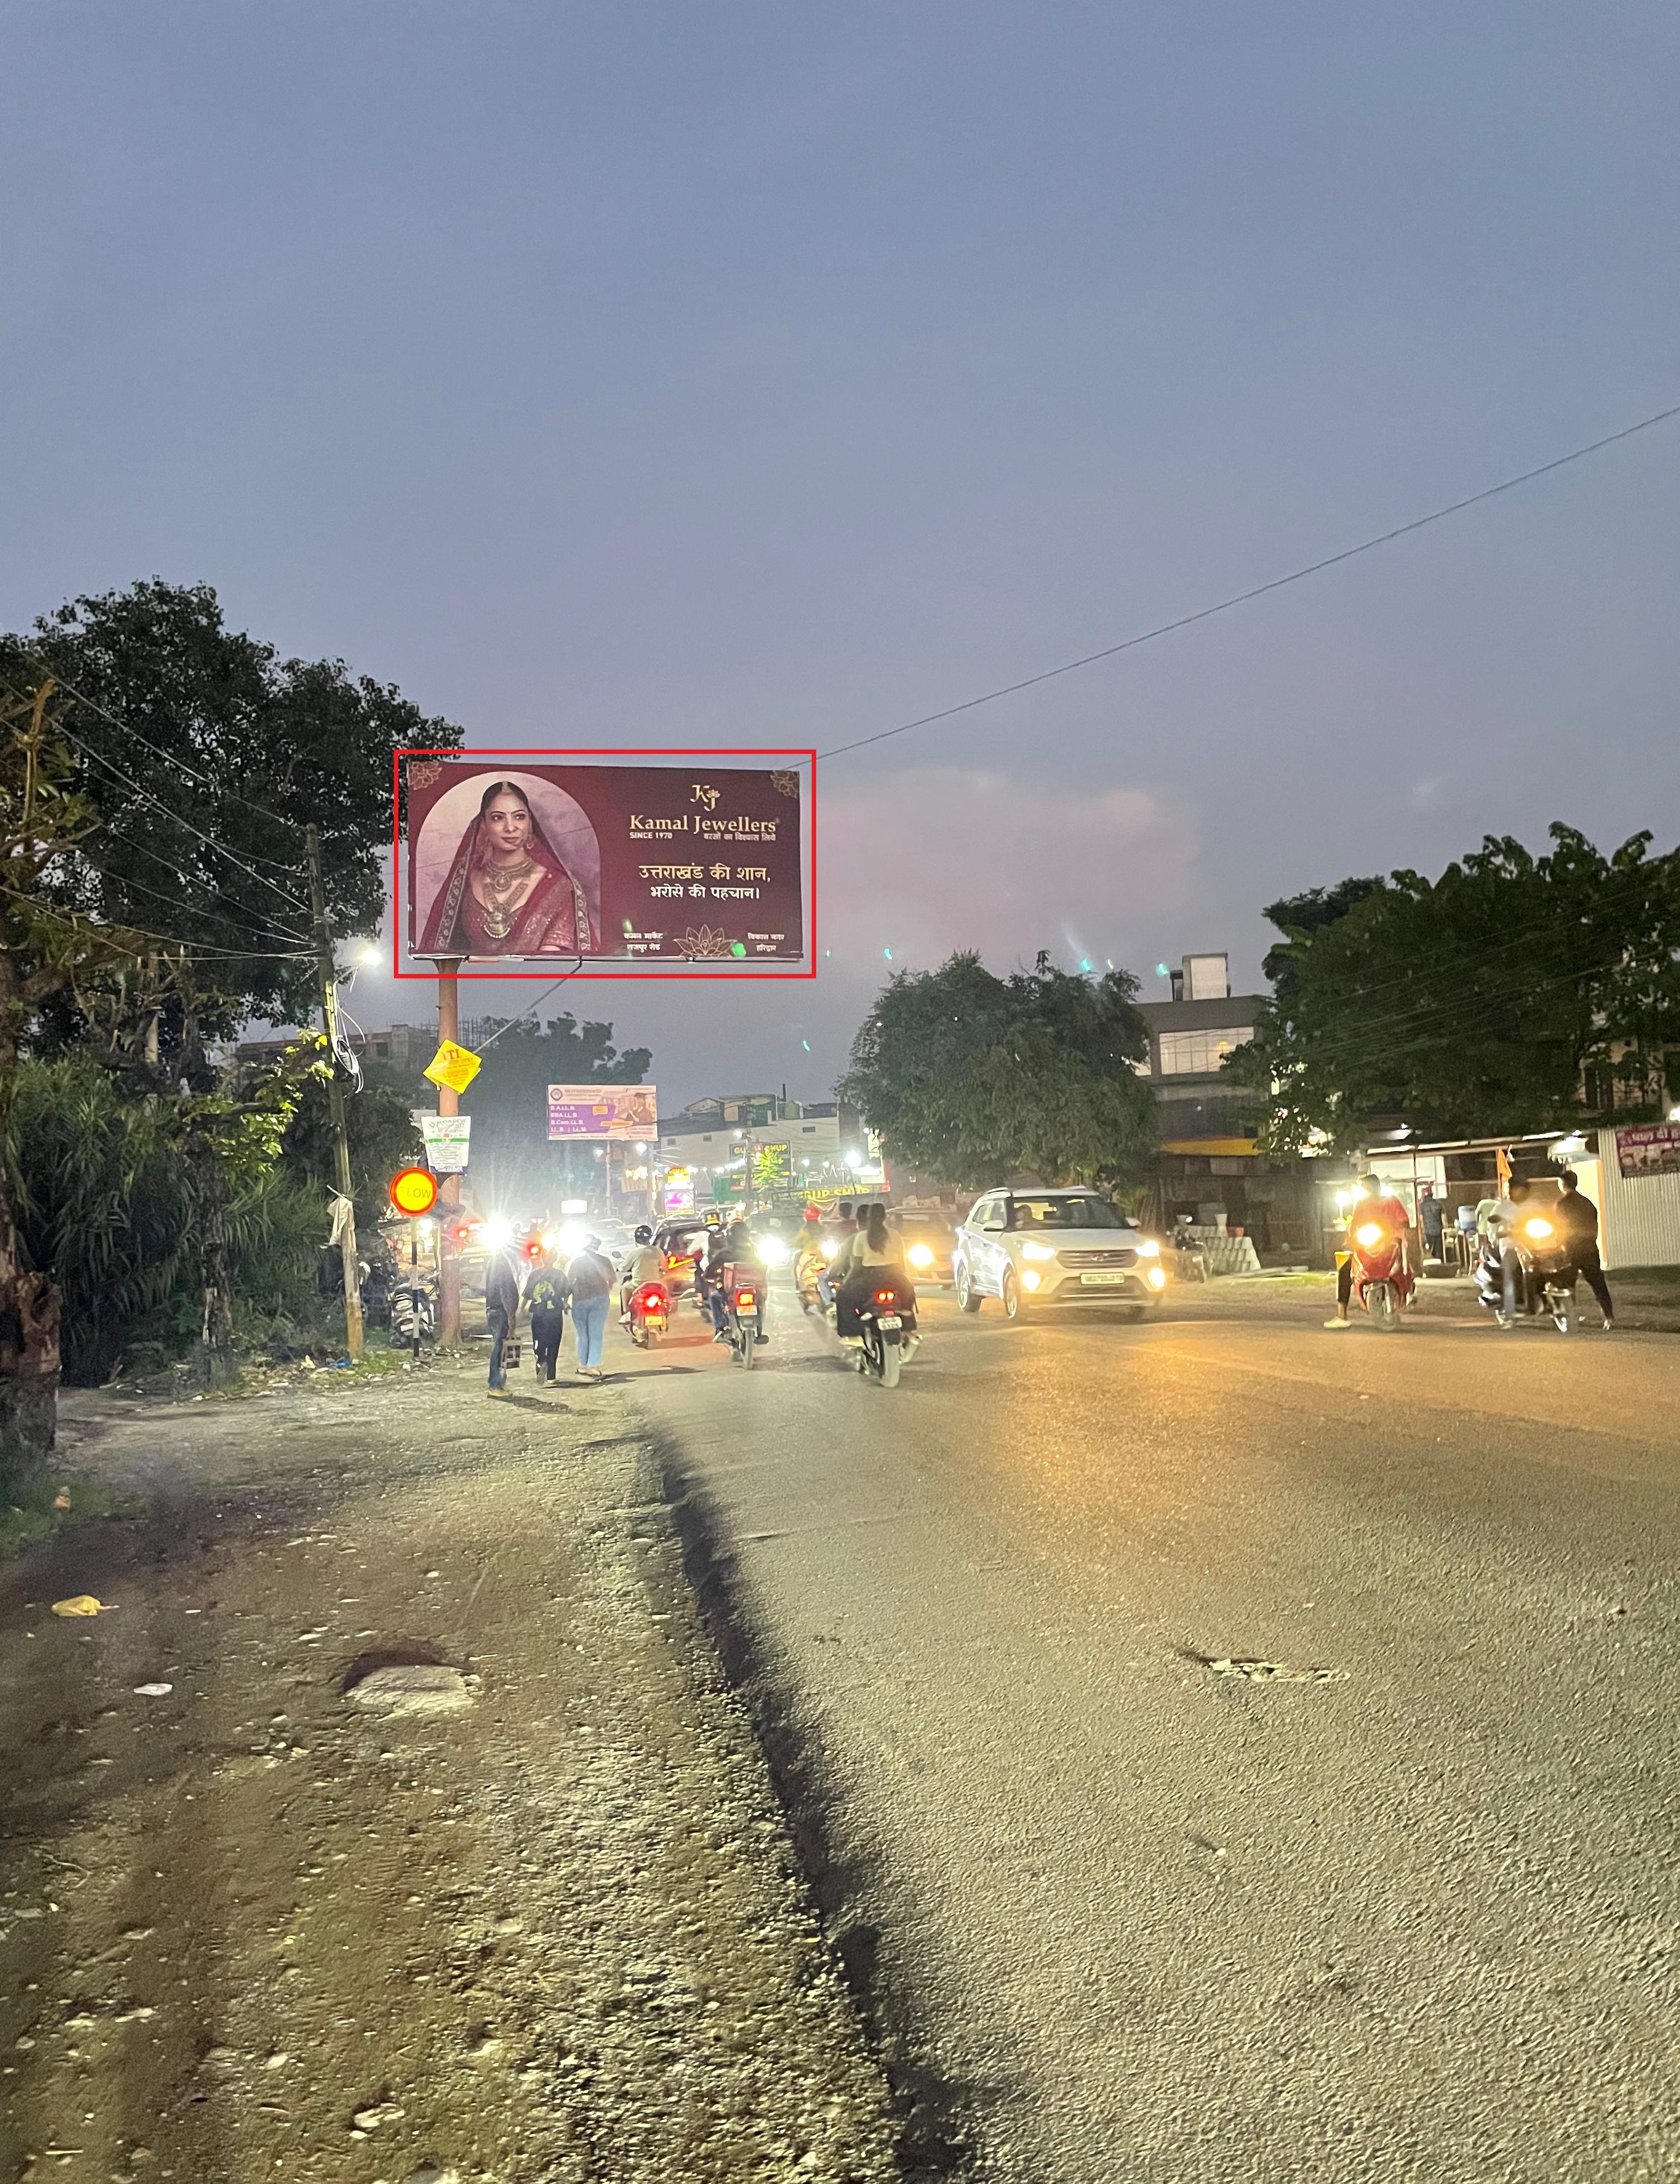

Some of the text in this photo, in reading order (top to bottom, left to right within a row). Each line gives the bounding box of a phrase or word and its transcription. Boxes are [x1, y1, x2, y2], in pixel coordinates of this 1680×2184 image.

[629, 814, 776, 834] Kamal Jewellers
[639, 862, 770, 882] उत्तराखंड की शान,
[651, 883, 760, 901] भरोसे की पहचान।
[398, 1187, 431, 1198] SLOW
